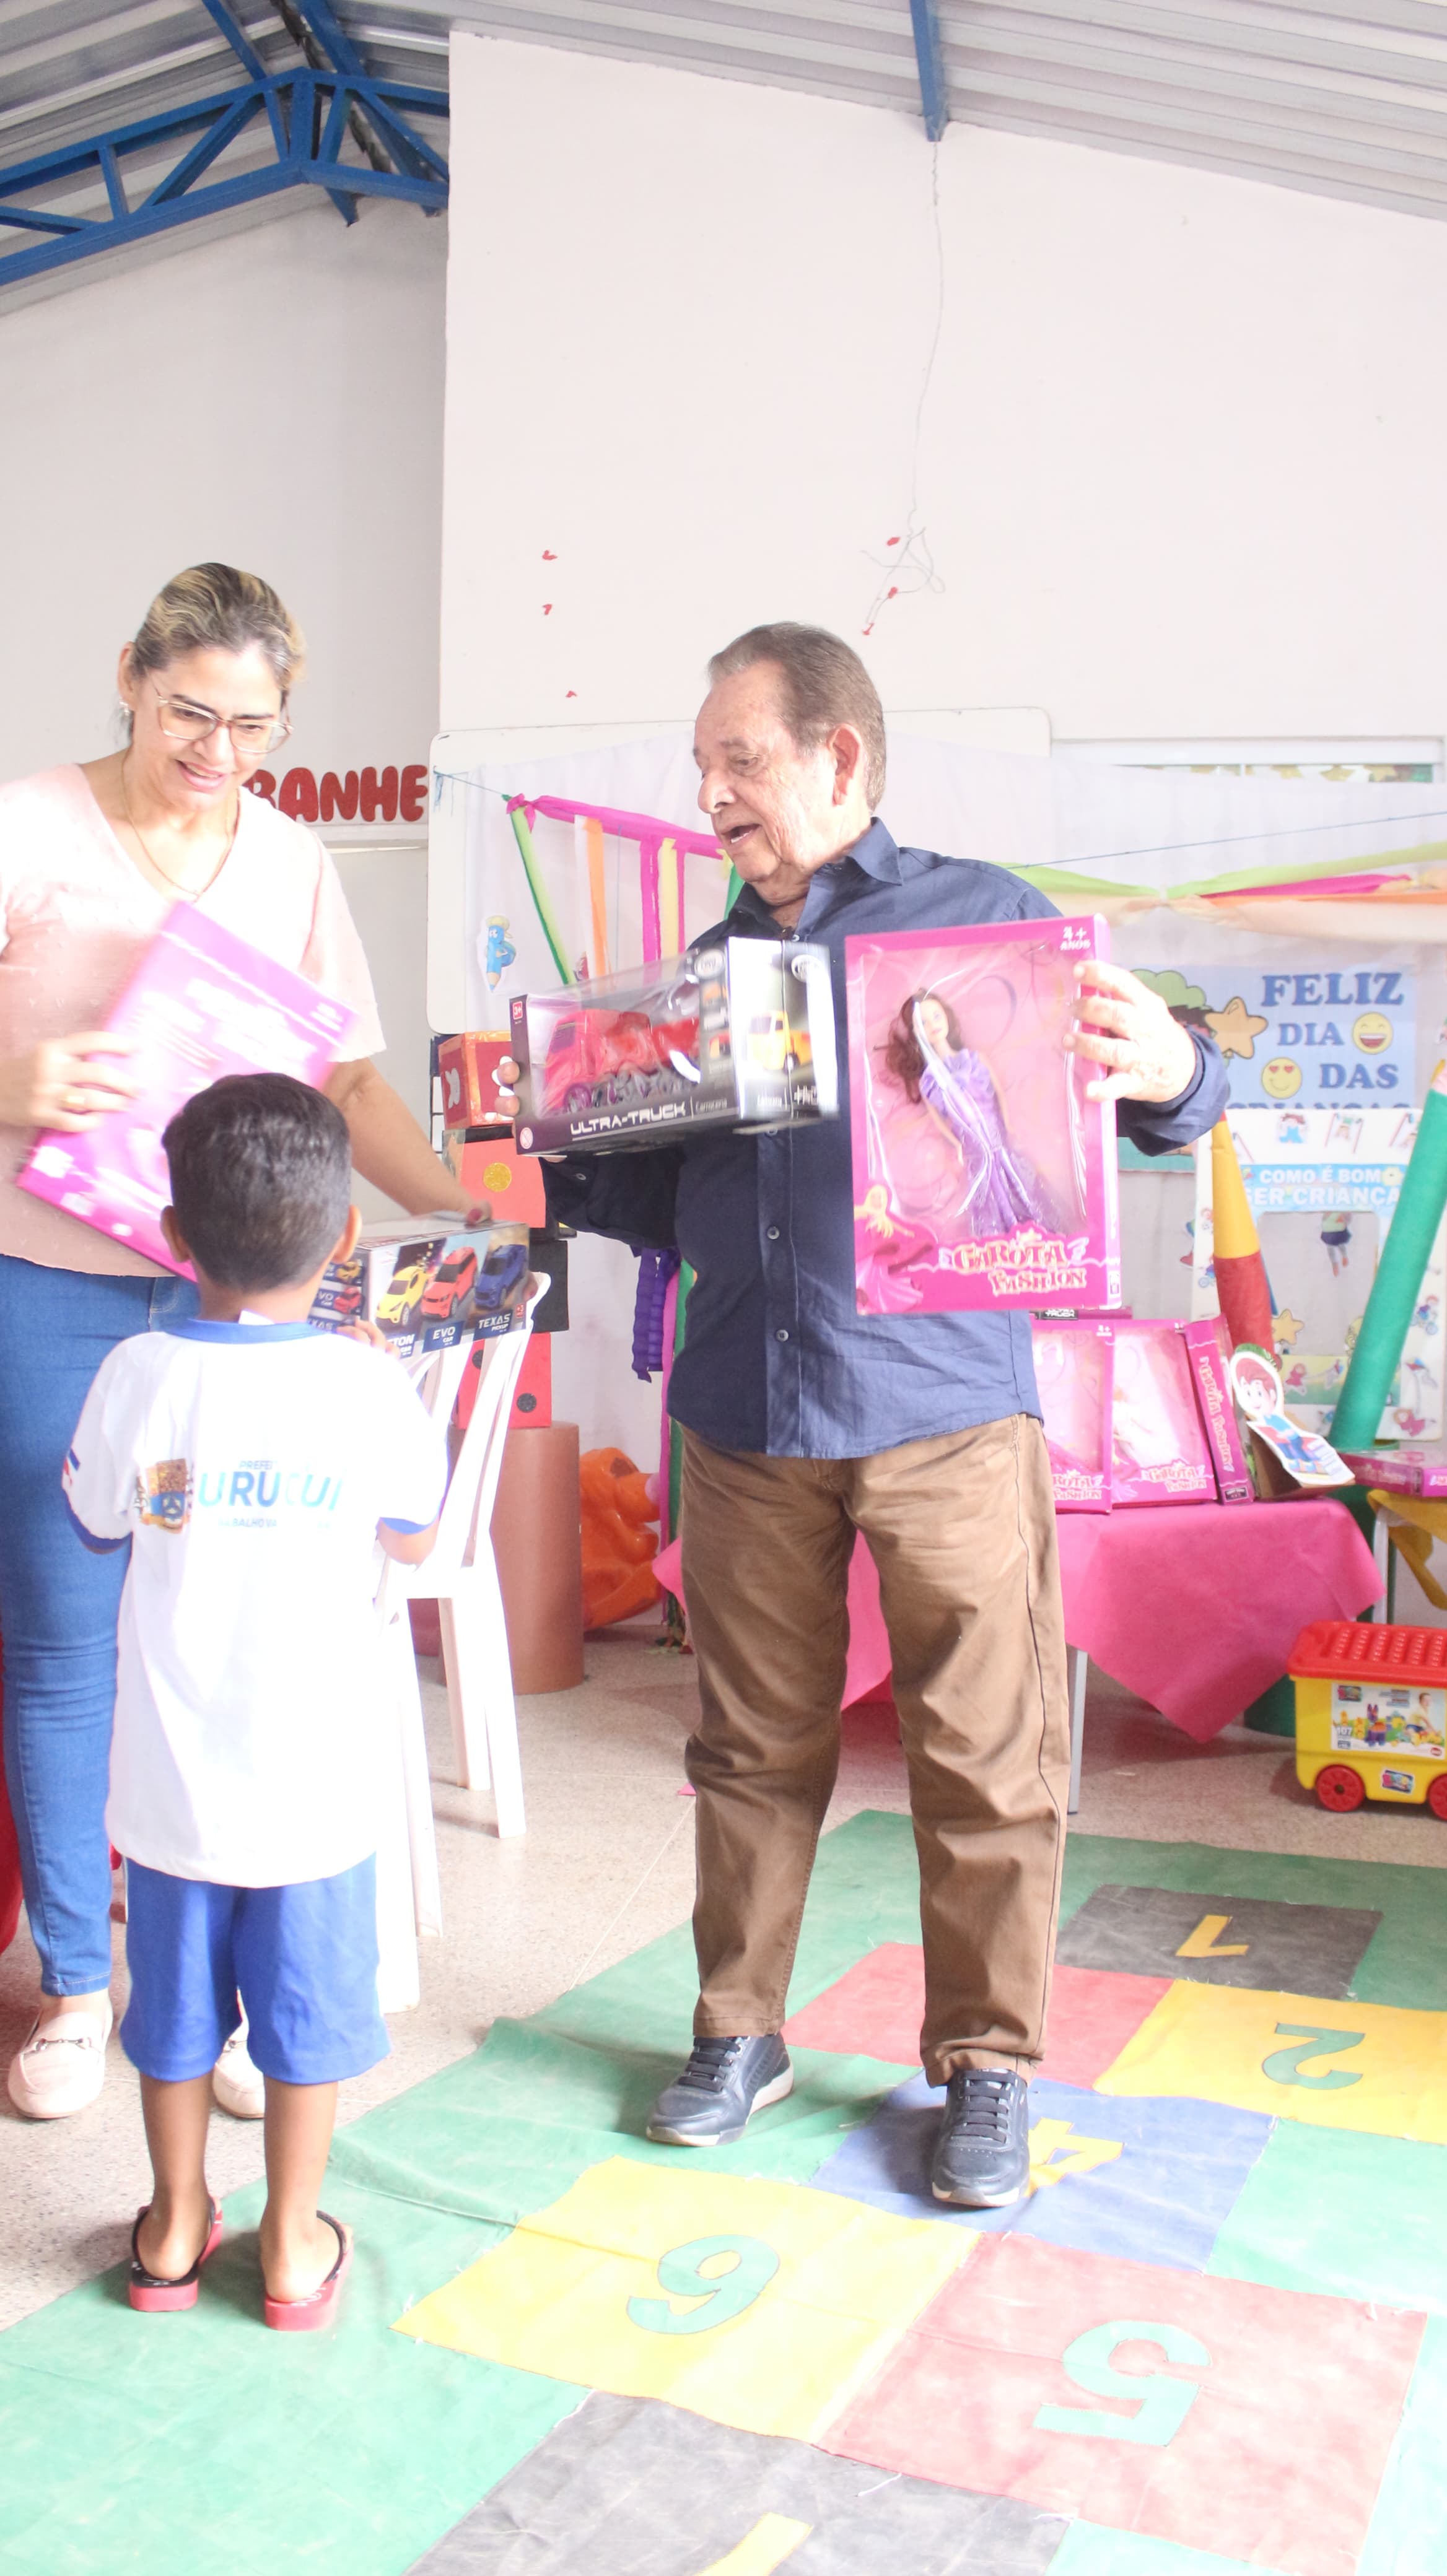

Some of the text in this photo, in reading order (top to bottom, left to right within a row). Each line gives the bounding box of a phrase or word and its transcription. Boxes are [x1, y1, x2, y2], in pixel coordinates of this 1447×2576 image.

[1261, 972, 1405, 1006] FELIZ
[1277, 1022, 1344, 1046] DIA
[1319, 1063, 1399, 1089] DAS
[570, 1101, 686, 1135] ULTRA-TRUCK
[1260, 1165, 1381, 1183] COMO É BOM
[1246, 1187, 1284, 1204] SER
[953, 1240, 1069, 1274] GAROTA
[988, 1267, 1086, 1296] FASHION
[433, 1326, 456, 1339] EVO
[478, 1313, 510, 1329] TEXAS
[1261, 2023, 1365, 2090] 2
[1023, 2117, 1124, 2198] 4
[1032, 2320, 1212, 2447] 5
